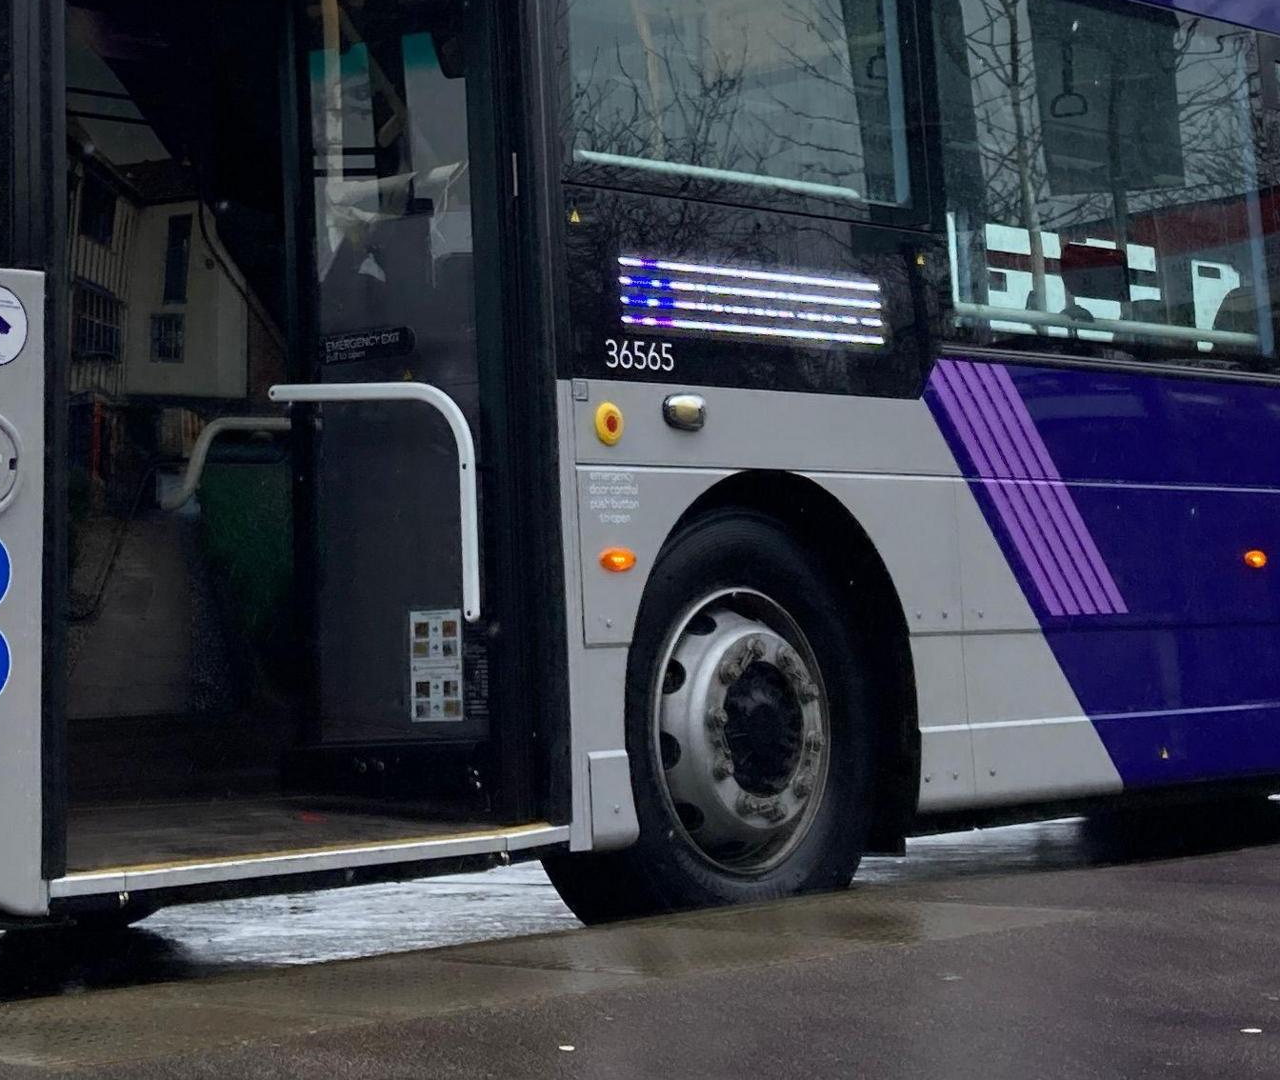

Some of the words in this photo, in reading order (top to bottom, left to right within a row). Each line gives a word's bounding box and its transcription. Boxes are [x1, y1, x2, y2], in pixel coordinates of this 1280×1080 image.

[325, 335, 380, 352] EMERGENCY
[380, 332, 400, 345] EXIT
[605, 339, 674, 371] 36565
